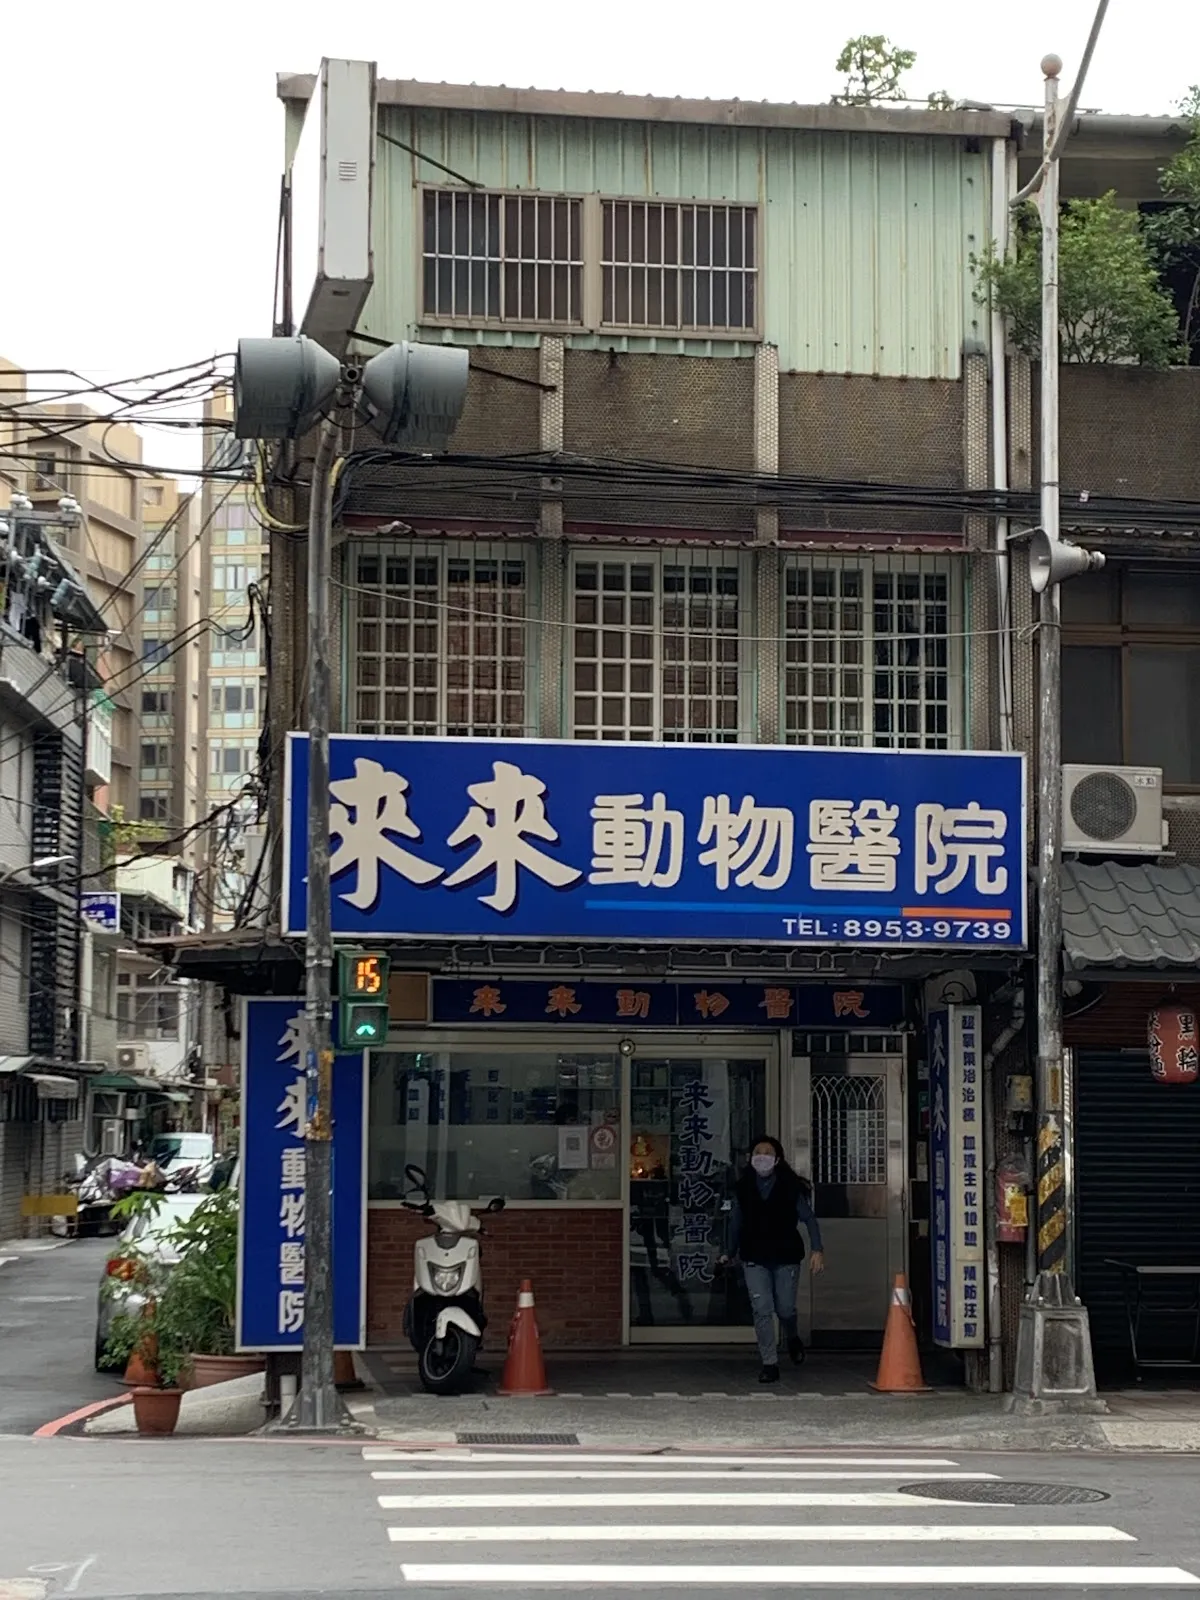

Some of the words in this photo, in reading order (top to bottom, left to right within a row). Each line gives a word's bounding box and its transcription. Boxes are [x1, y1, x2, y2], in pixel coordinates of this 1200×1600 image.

[303, 758, 1008, 911] 來來動物醫院
[357, 958, 381, 993] 15
